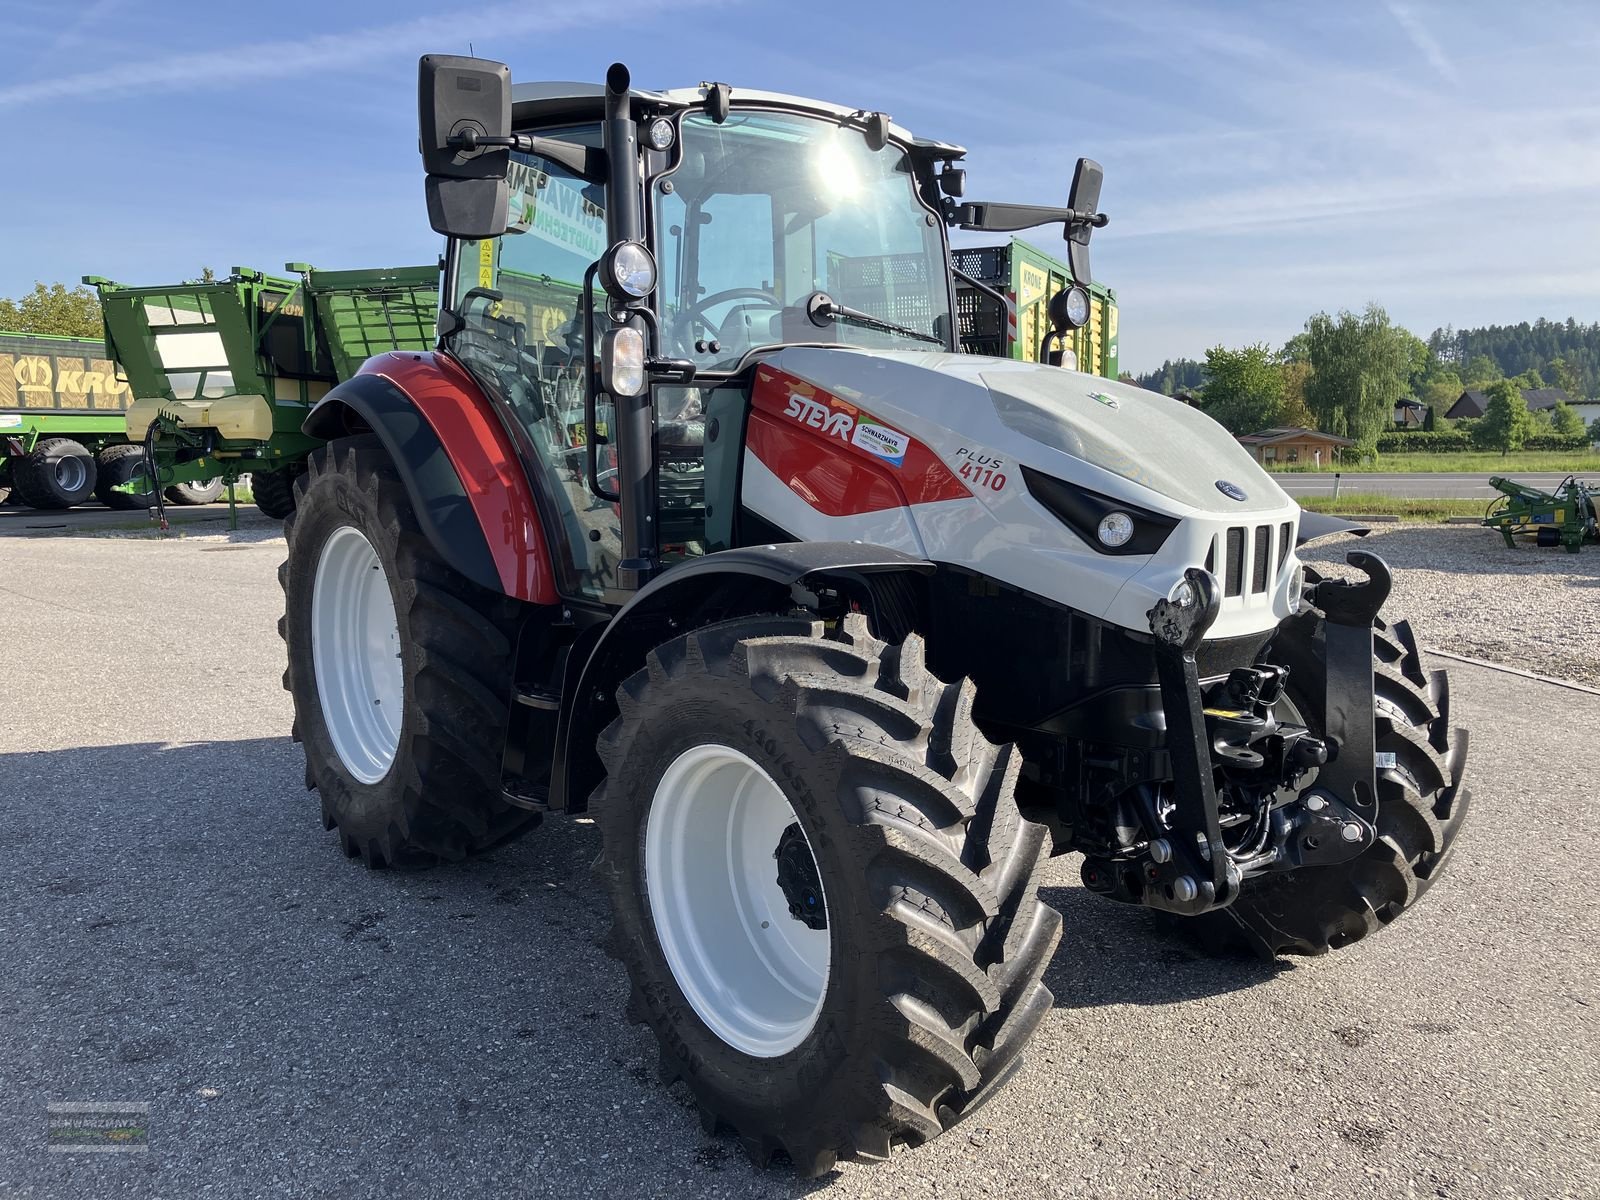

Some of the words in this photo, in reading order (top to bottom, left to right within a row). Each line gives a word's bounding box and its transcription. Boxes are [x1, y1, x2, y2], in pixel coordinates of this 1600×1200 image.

[1024, 270, 1041, 290] KRONE
[56, 371, 129, 394] KRO
[784, 394, 854, 441] STEYR
[861, 425, 898, 447] SCHWARZMAYR
[956, 447, 1003, 469] PLUS
[959, 461, 1007, 491] 4110
[888, 756, 916, 772] RADIAL
